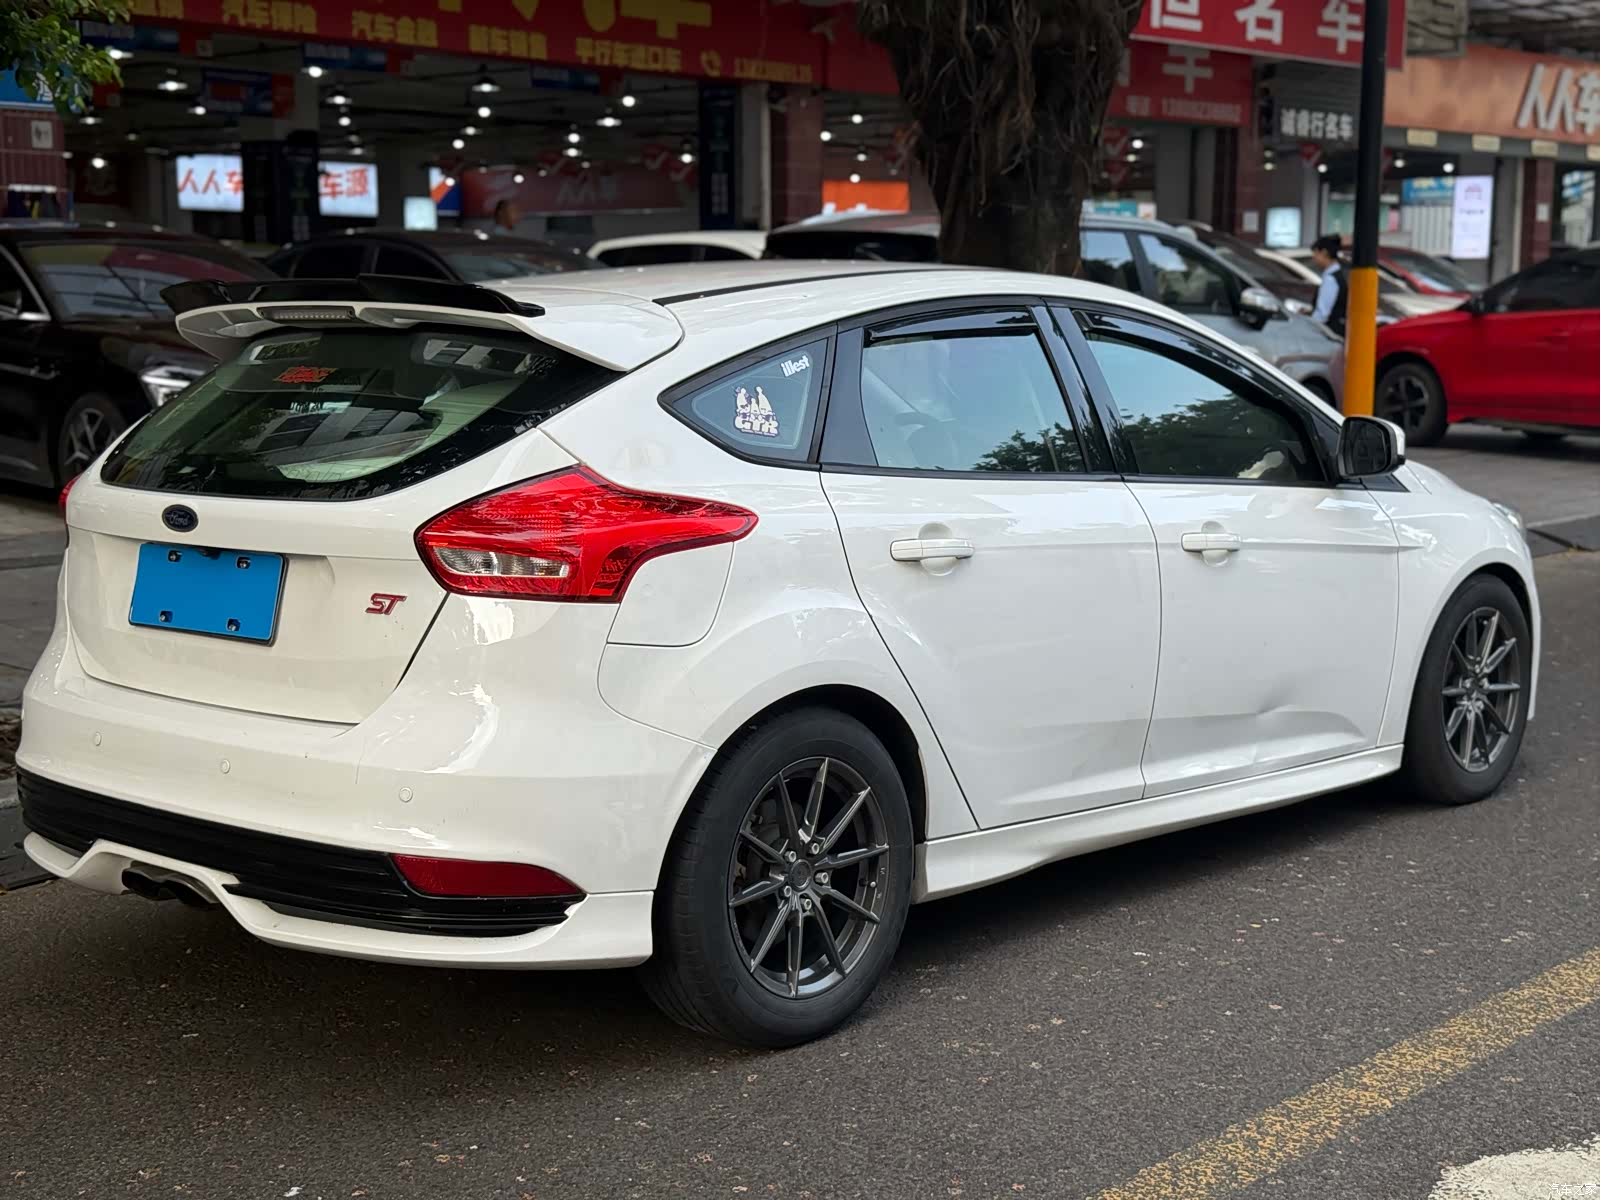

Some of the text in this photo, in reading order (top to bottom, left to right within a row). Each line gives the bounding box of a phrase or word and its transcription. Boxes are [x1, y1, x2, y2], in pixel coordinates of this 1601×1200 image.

[780, 354, 810, 377] illest
[165, 510, 189, 527] Ford
[365, 592, 407, 615] ST
